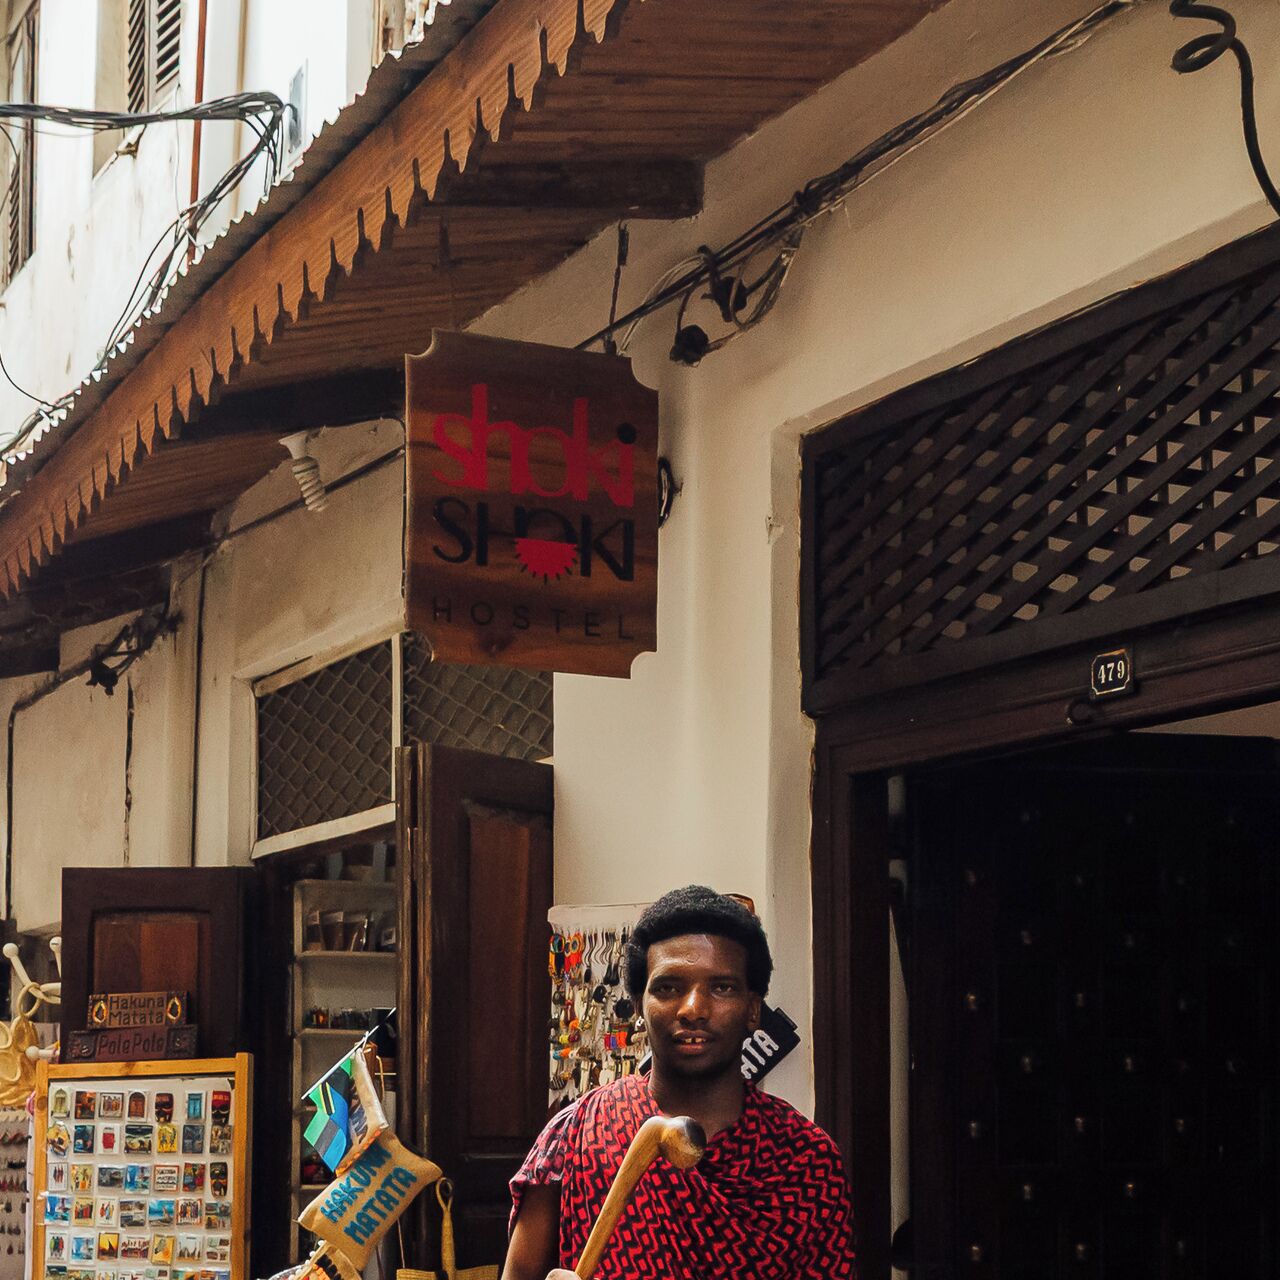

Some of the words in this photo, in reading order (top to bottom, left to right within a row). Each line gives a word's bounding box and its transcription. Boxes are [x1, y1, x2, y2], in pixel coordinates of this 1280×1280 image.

[432, 383, 637, 508] shoki
[432, 496, 635, 584] SHOKI
[432, 597, 635, 640] HOSTEL
[1097, 660, 1125, 684] 479
[108, 1009, 164, 1025] Matata
[109, 995, 164, 1009] Hakuna
[343, 1166, 418, 1247] MATATA
